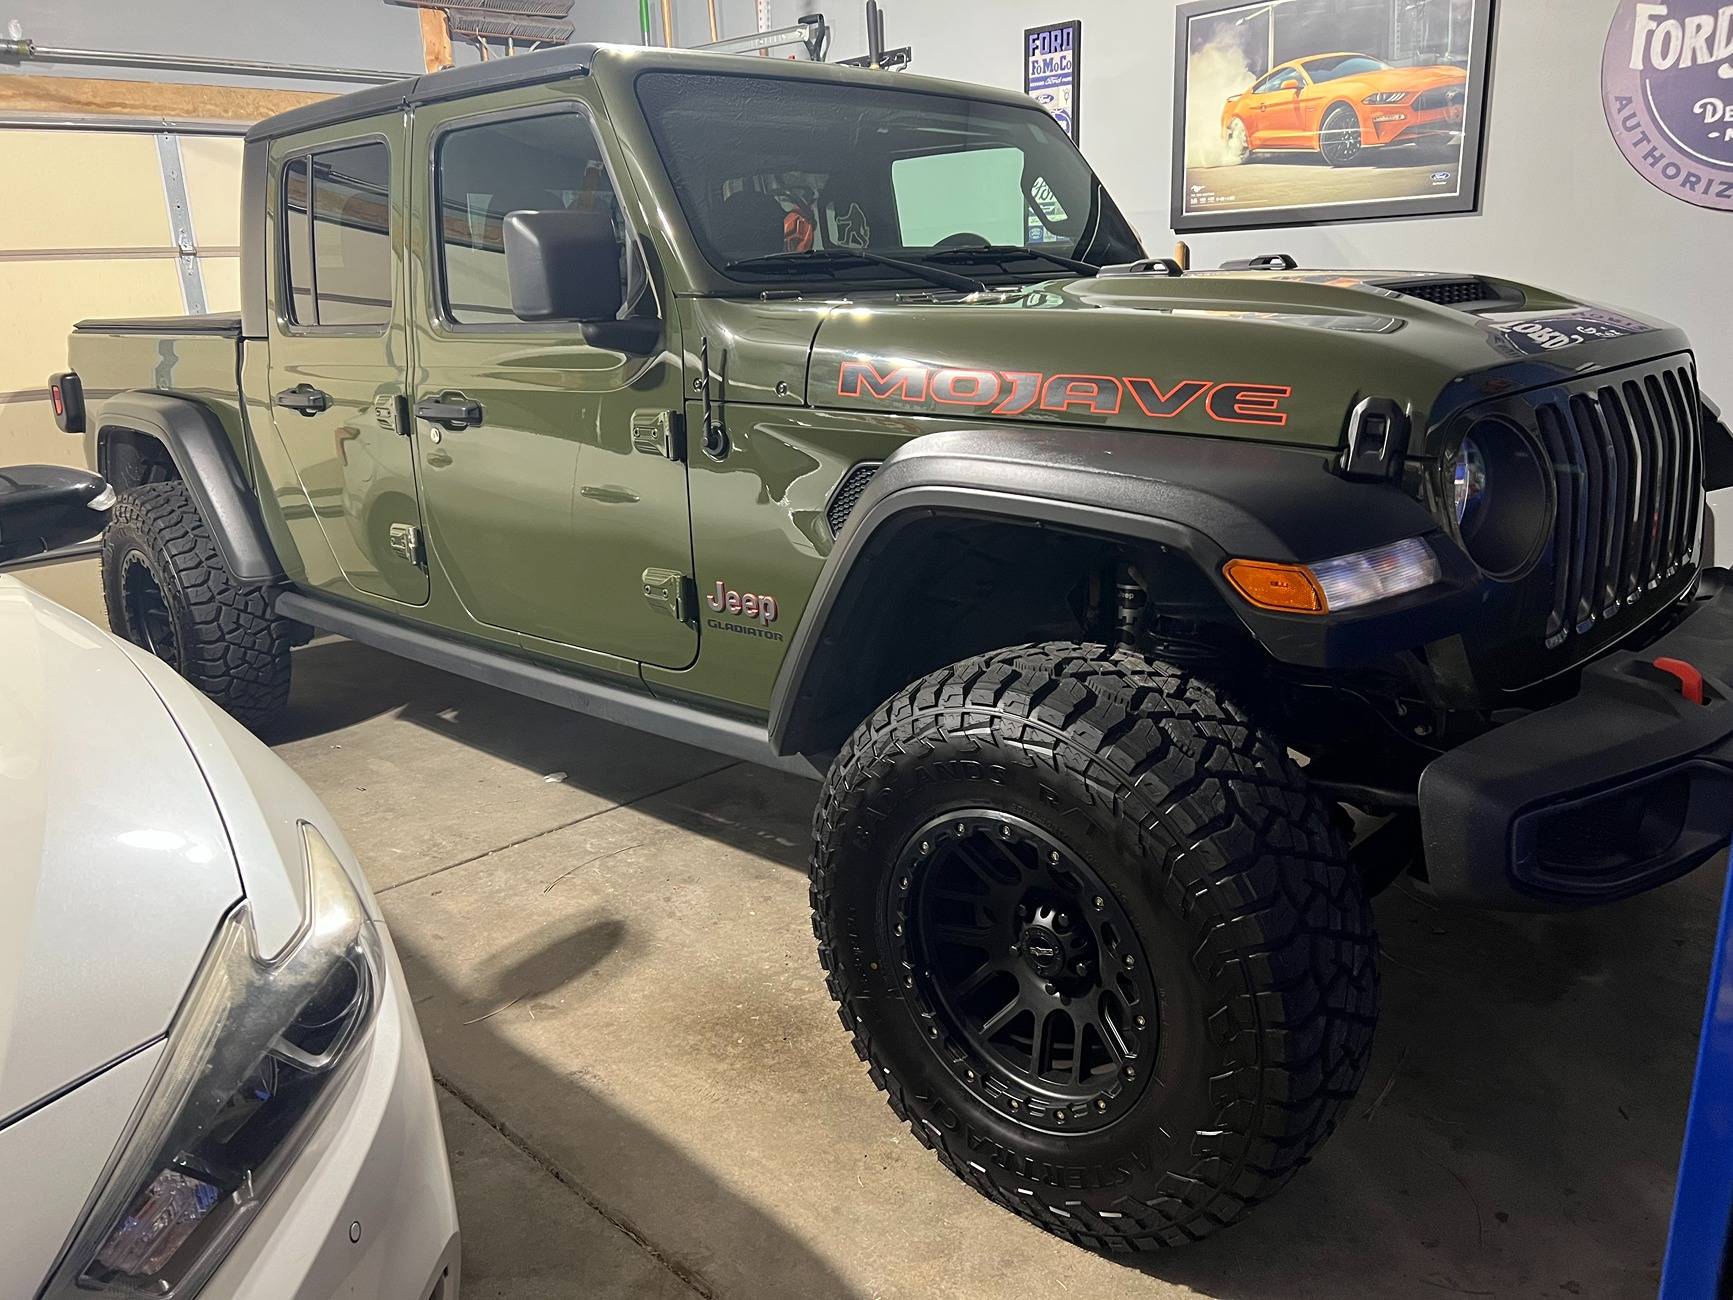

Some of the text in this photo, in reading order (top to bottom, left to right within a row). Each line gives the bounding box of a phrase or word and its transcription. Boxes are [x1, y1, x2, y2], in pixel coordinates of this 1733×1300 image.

[1029, 28, 1073, 57] FORD
[838, 362, 1291, 425] MOJAVE
[707, 581, 778, 627] Jeep
[707, 619, 784, 641] GLADIATOR
